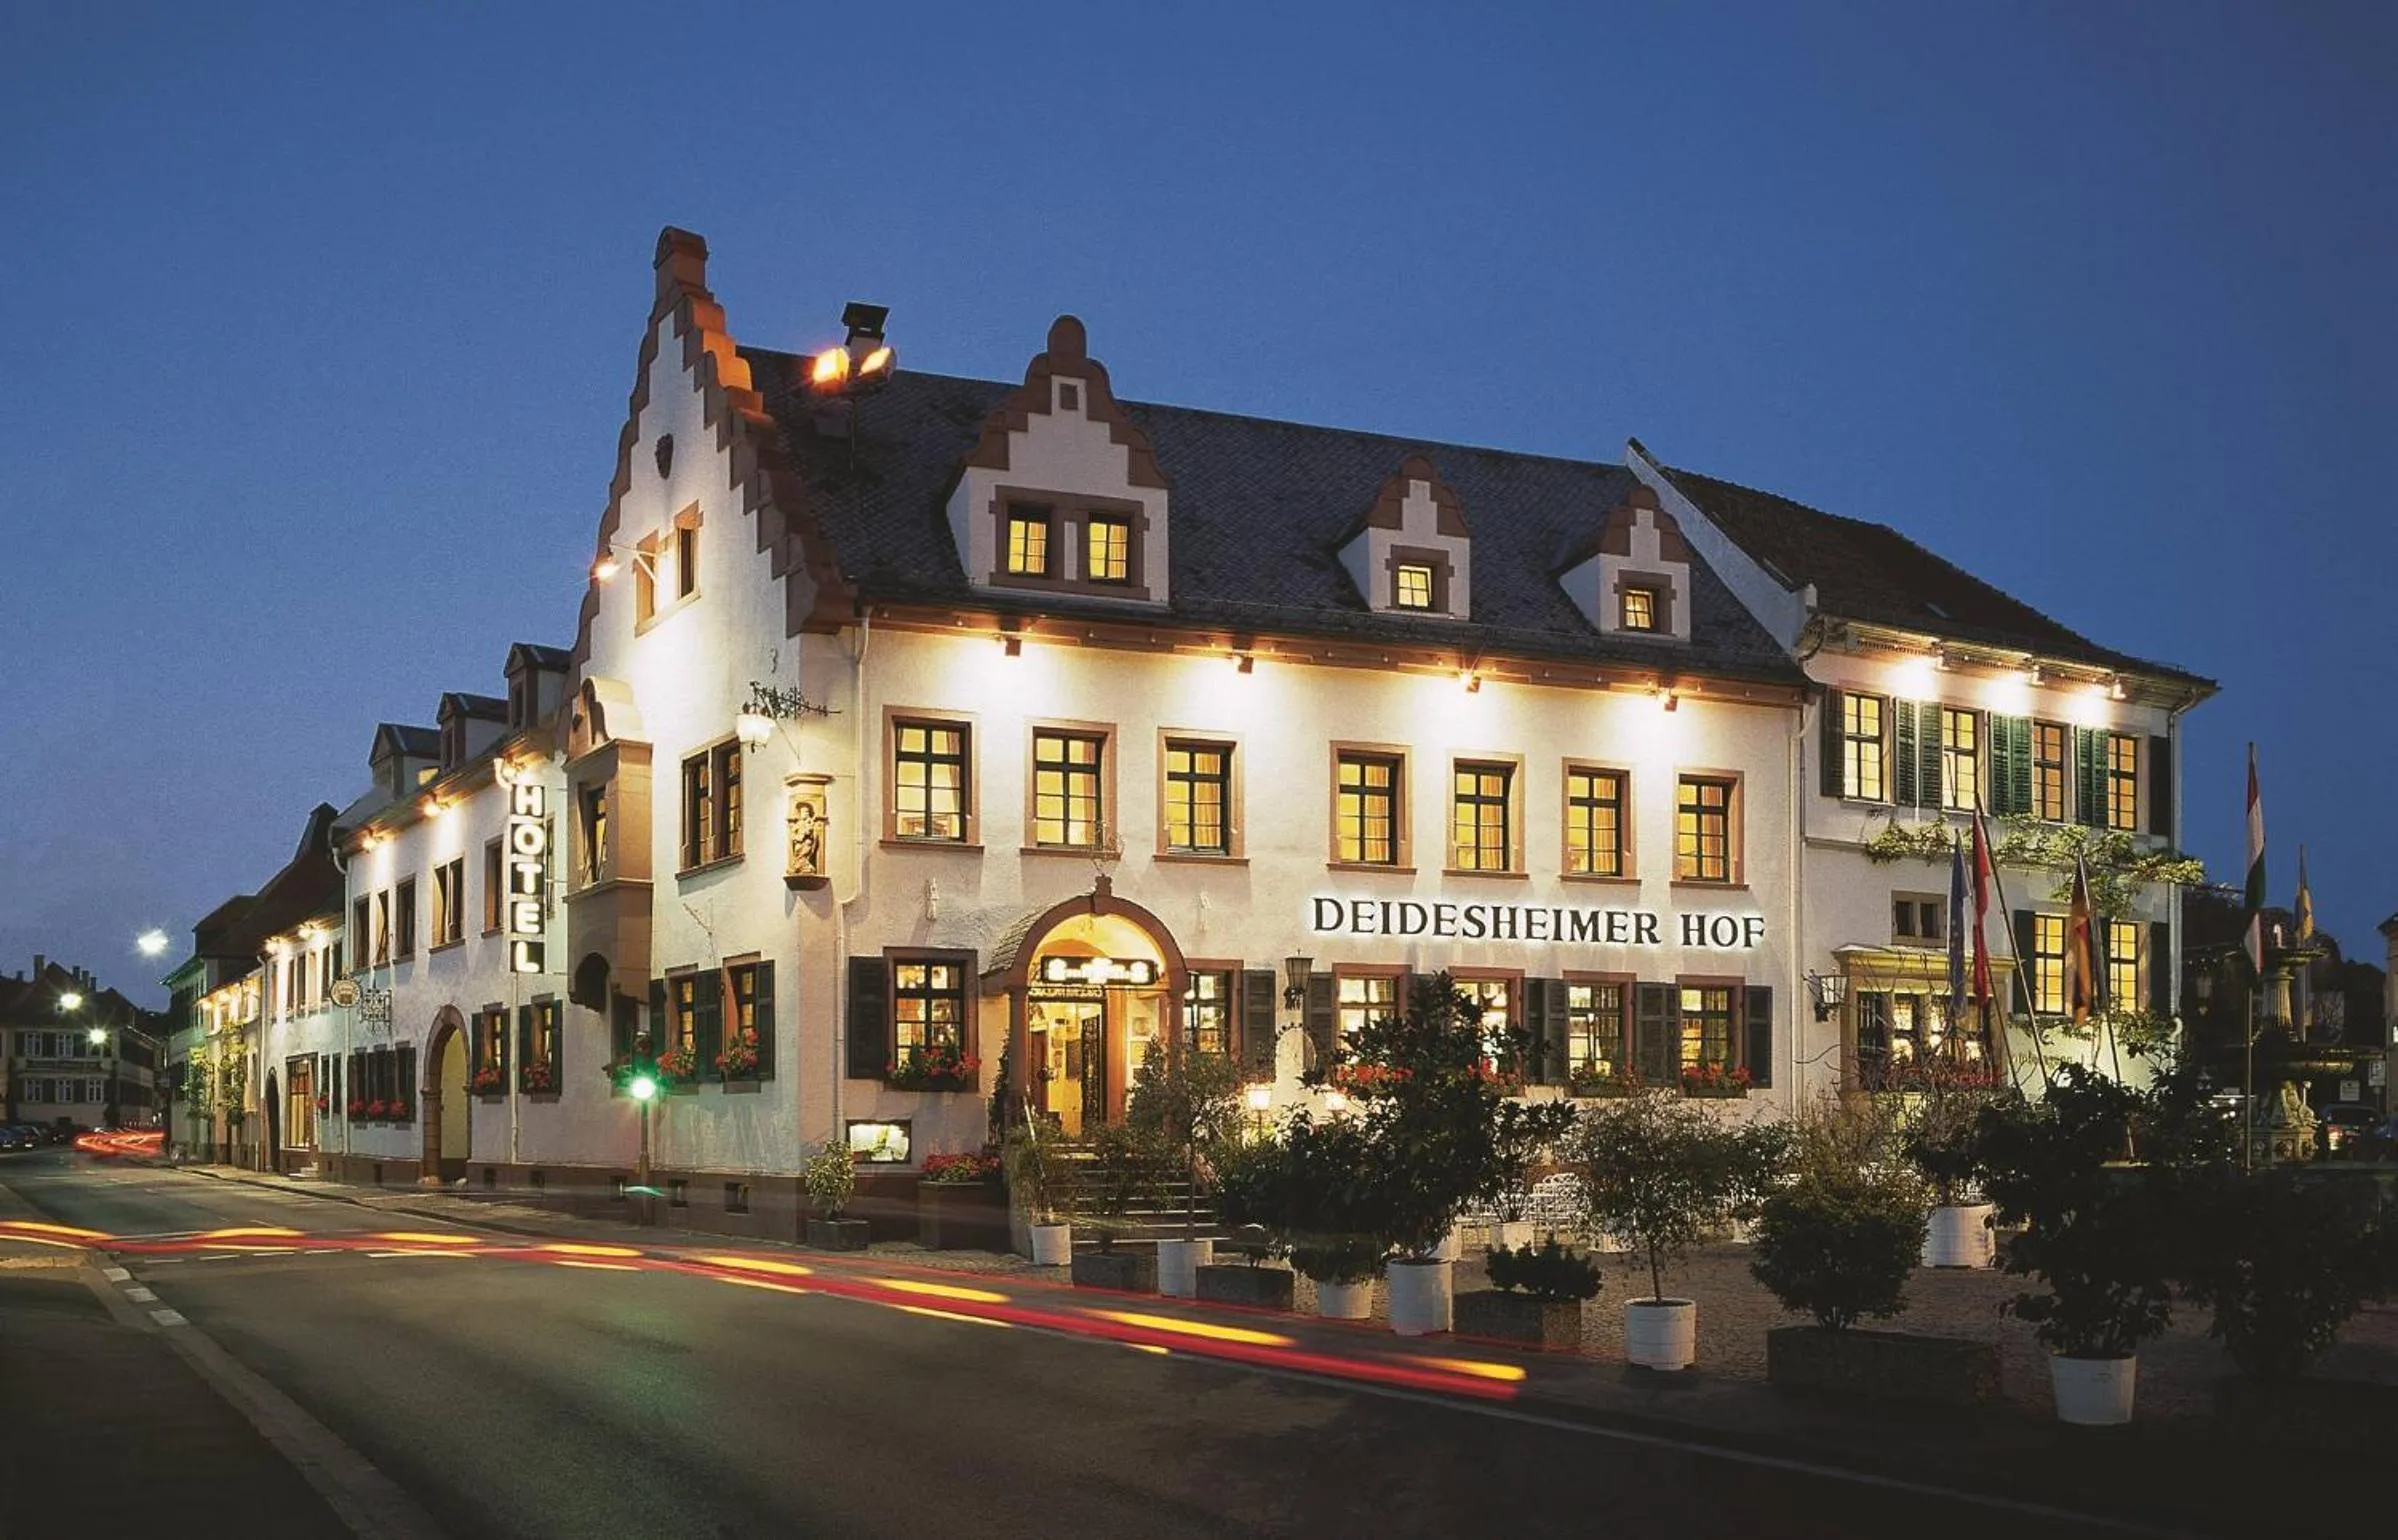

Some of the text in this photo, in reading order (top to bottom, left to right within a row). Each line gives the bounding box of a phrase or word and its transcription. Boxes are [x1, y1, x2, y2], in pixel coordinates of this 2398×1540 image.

[513, 785, 545, 973] HOTEL
[1313, 897, 1766, 948] DEIDESHEIMER HOF
